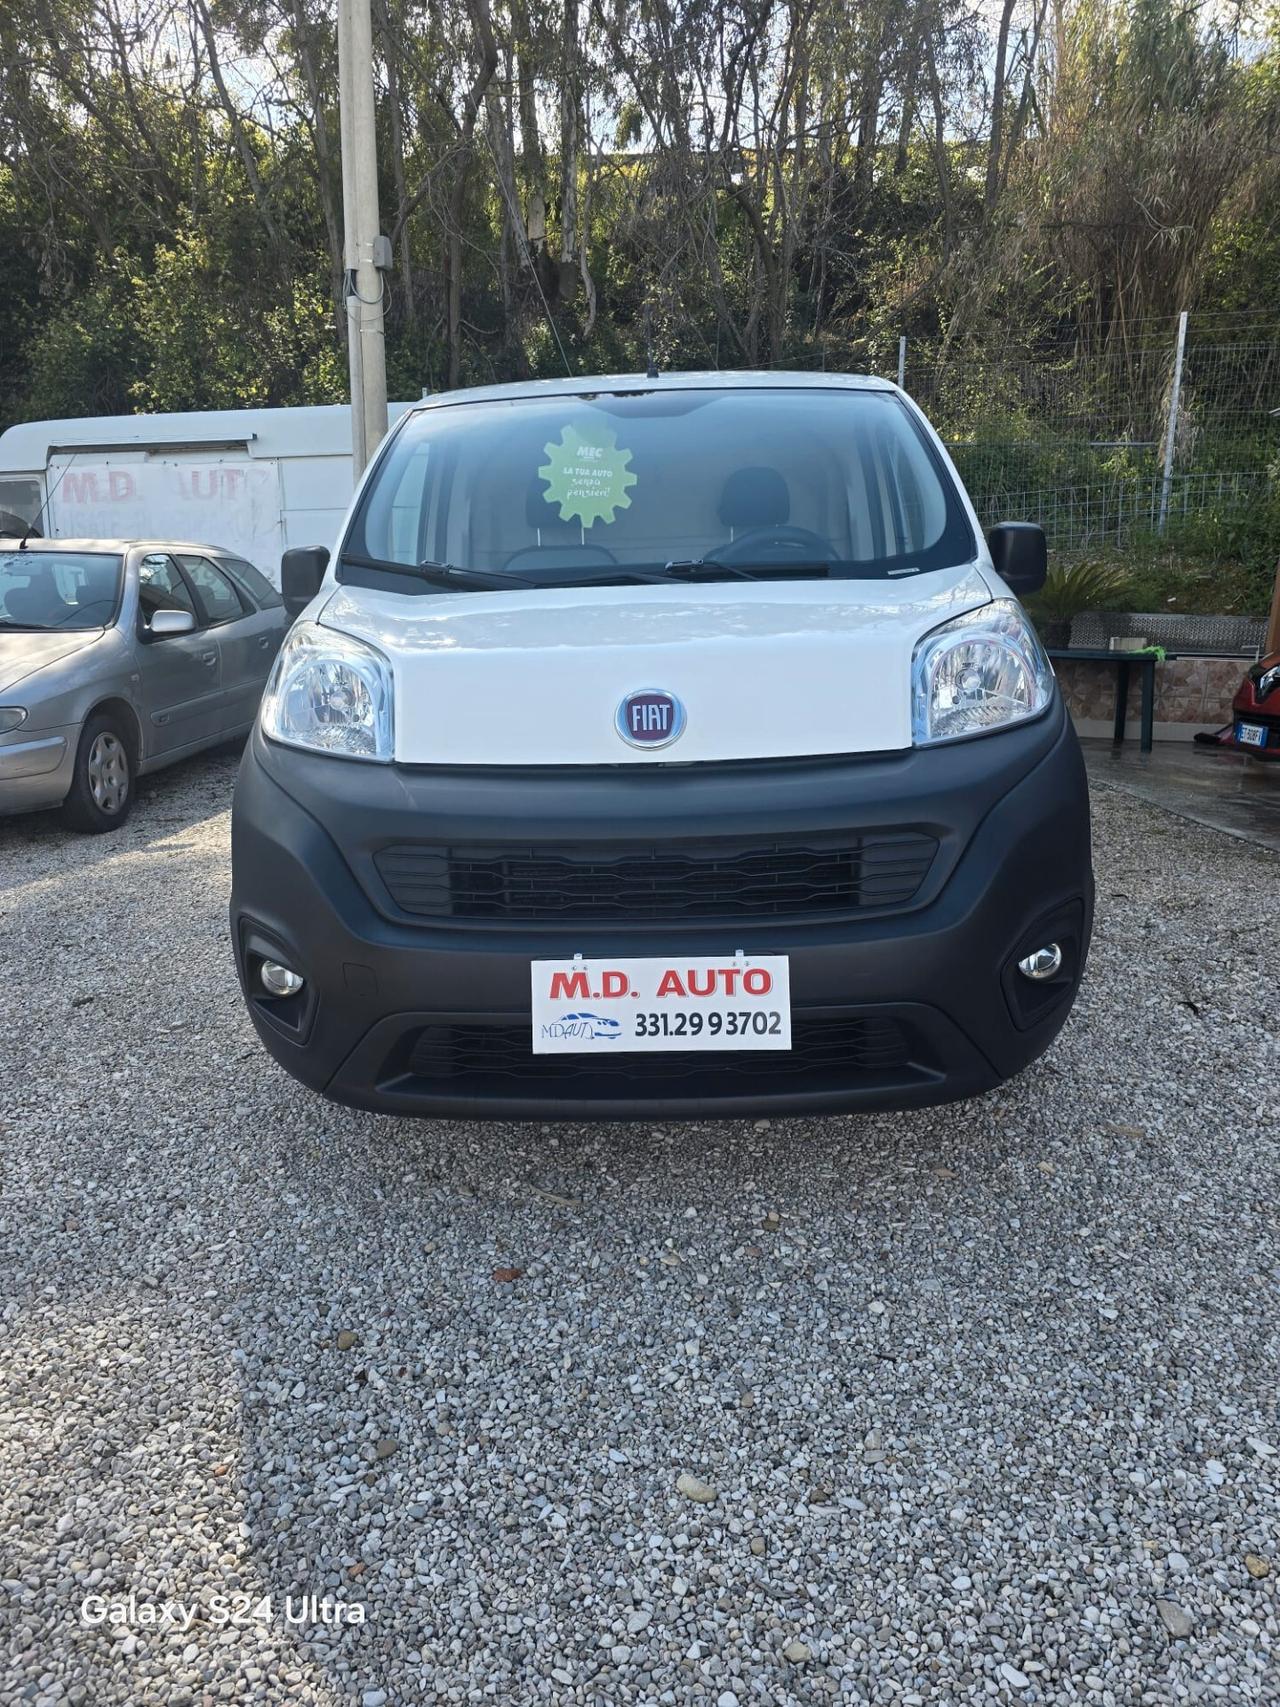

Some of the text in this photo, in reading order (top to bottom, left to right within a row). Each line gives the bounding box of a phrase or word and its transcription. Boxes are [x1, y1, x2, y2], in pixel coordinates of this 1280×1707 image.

[575, 467, 590, 476] TUA
[592, 468, 613, 478] AUTO
[632, 704, 671, 732] FIAT
[549, 968, 773, 1000] M.D. AUTO
